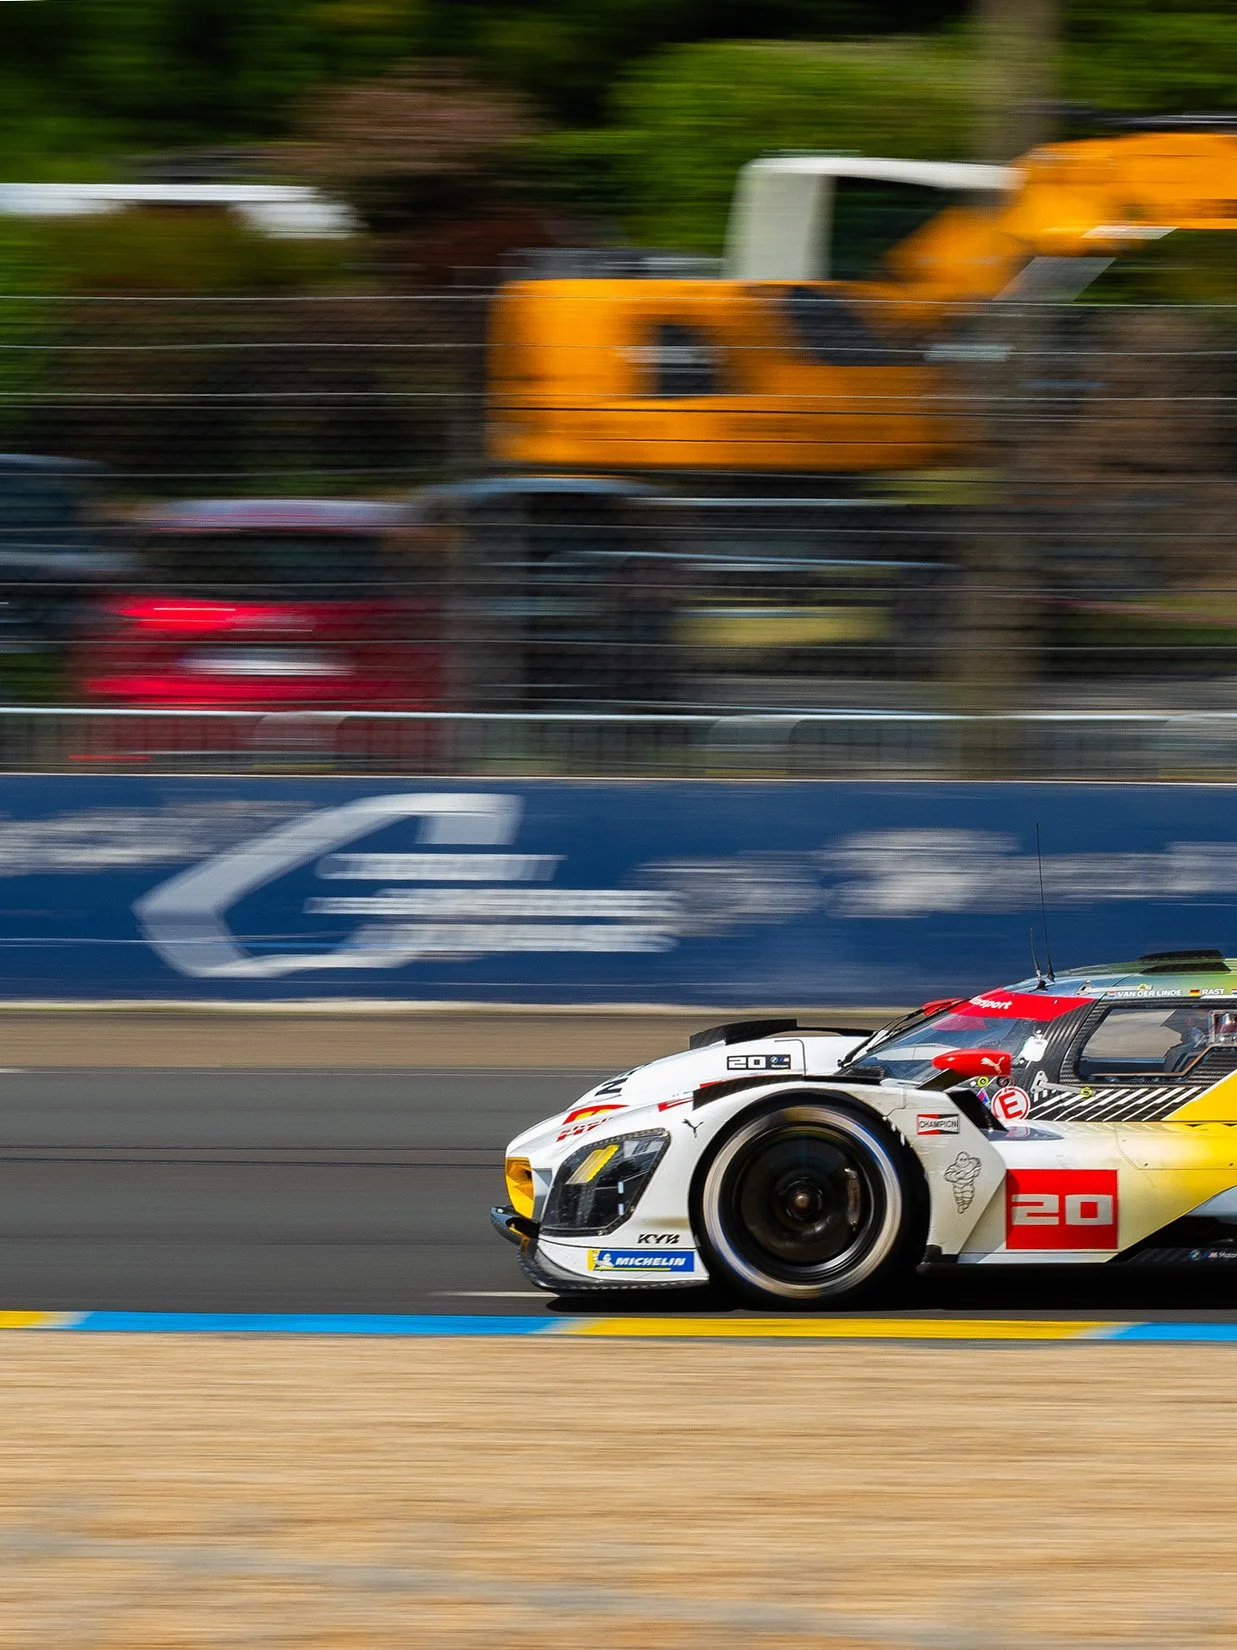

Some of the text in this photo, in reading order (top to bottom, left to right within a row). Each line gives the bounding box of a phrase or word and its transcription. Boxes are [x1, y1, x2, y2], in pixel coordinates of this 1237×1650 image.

[729, 1056, 766, 1069] 20
[999, 1091, 1023, 1119] E
[919, 1120, 959, 1129] CHAMPION
[1011, 1193, 1114, 1226] 20
[637, 1234, 680, 1244] KYB
[615, 1257, 686, 1266] MICHELIN
